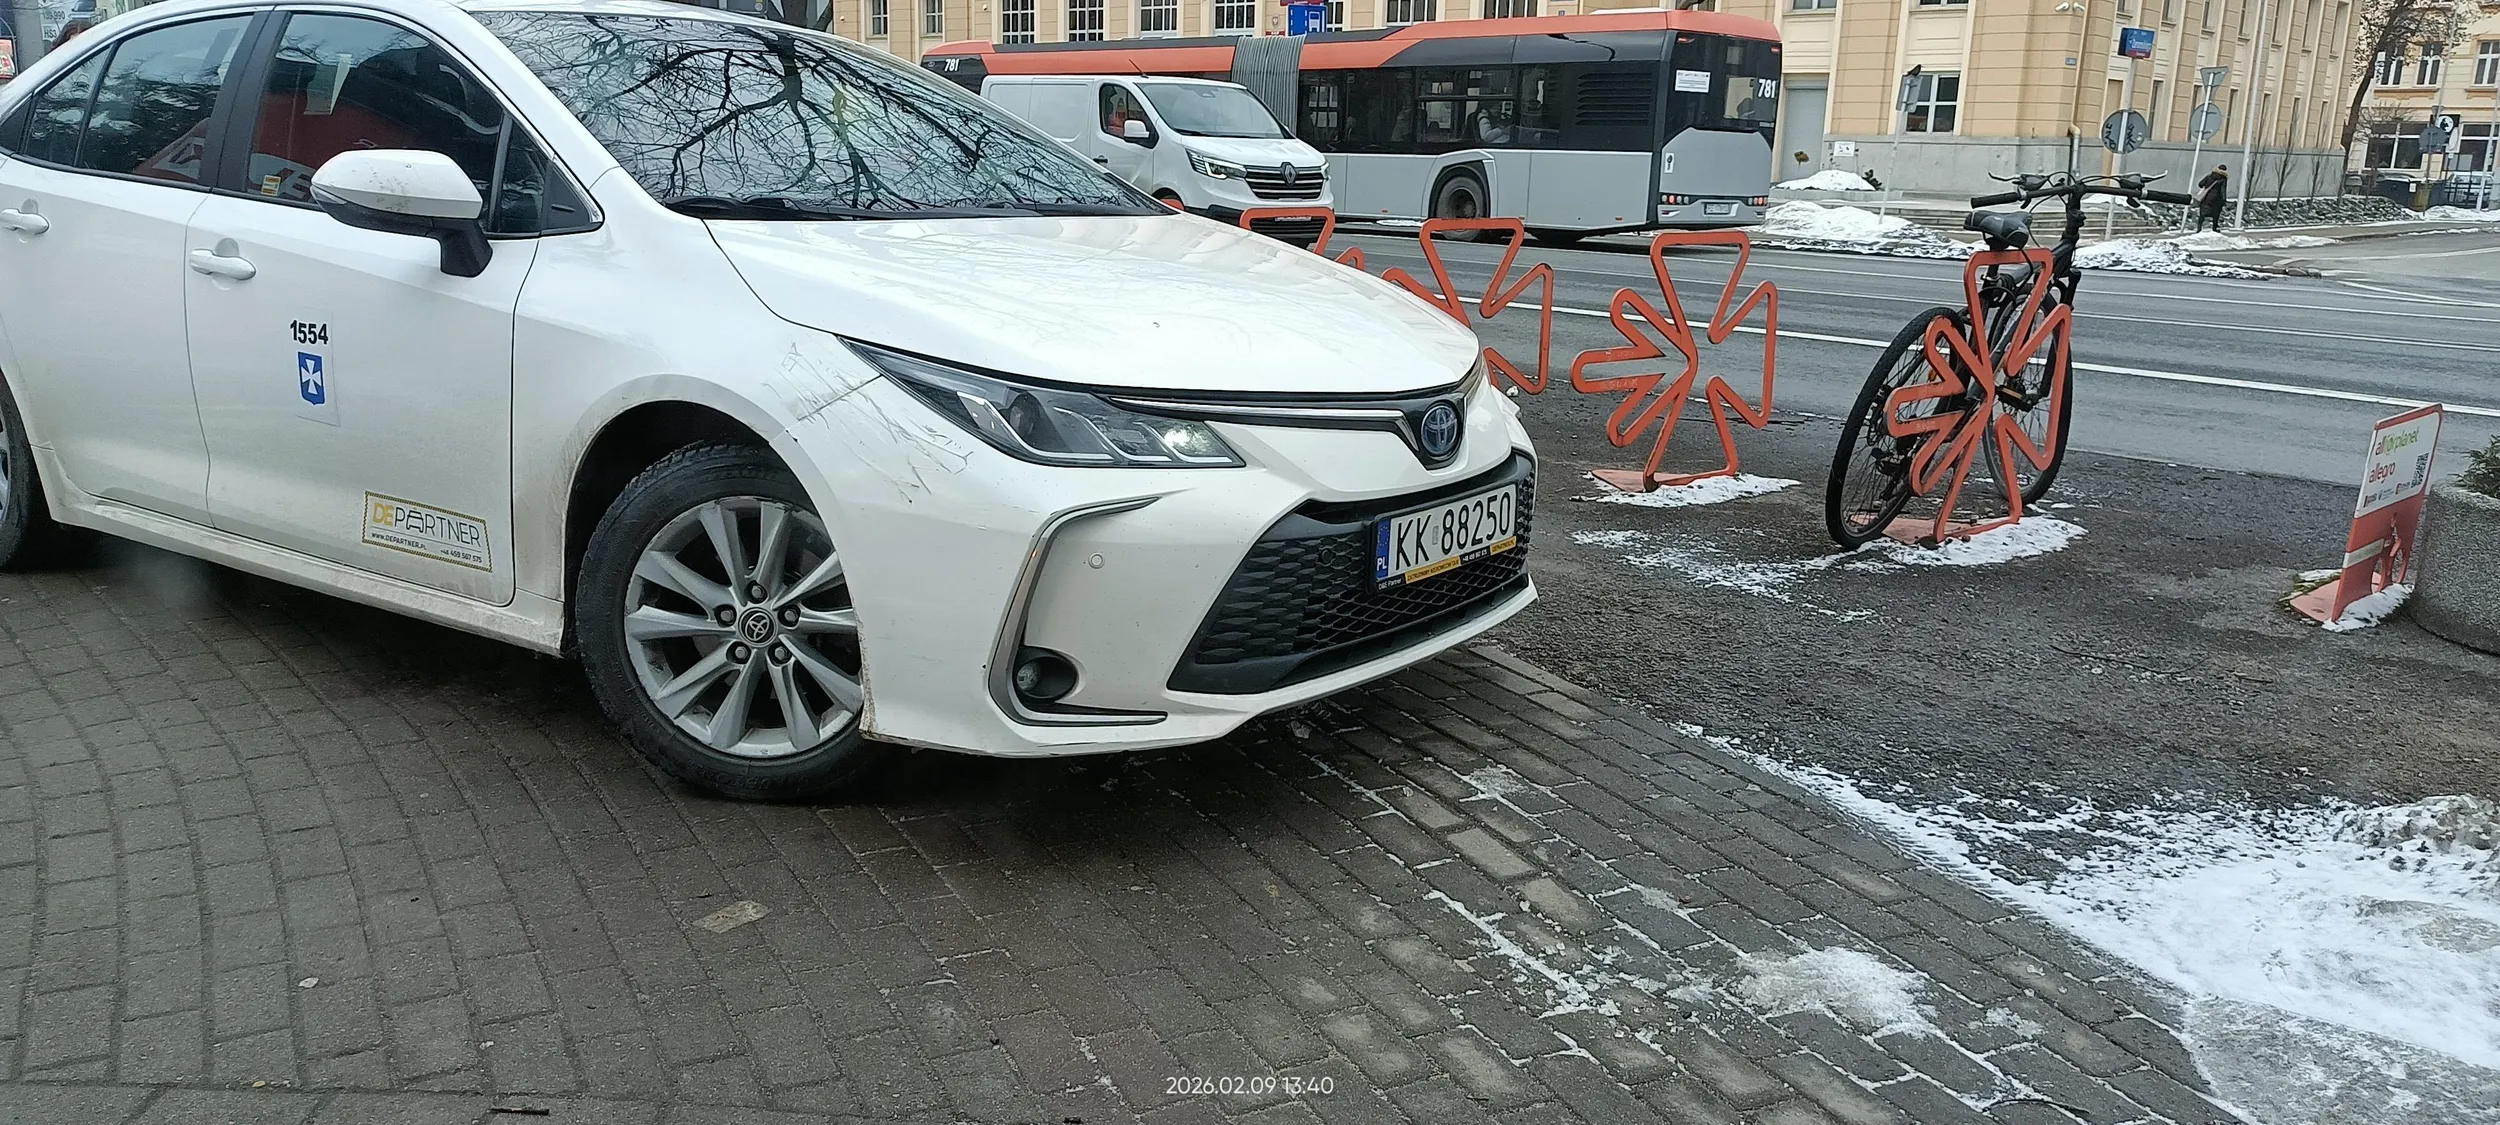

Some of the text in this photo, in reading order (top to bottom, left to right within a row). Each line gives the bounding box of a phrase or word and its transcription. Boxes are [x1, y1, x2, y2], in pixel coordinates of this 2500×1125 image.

[944, 59, 960, 72] 781
[1758, 79, 1776, 98] 781
[290, 319, 329, 345] 1554
[2369, 462, 2396, 484] allegro
[1396, 492, 1511, 571] KK 88250
[1376, 556, 1388, 572] PL
